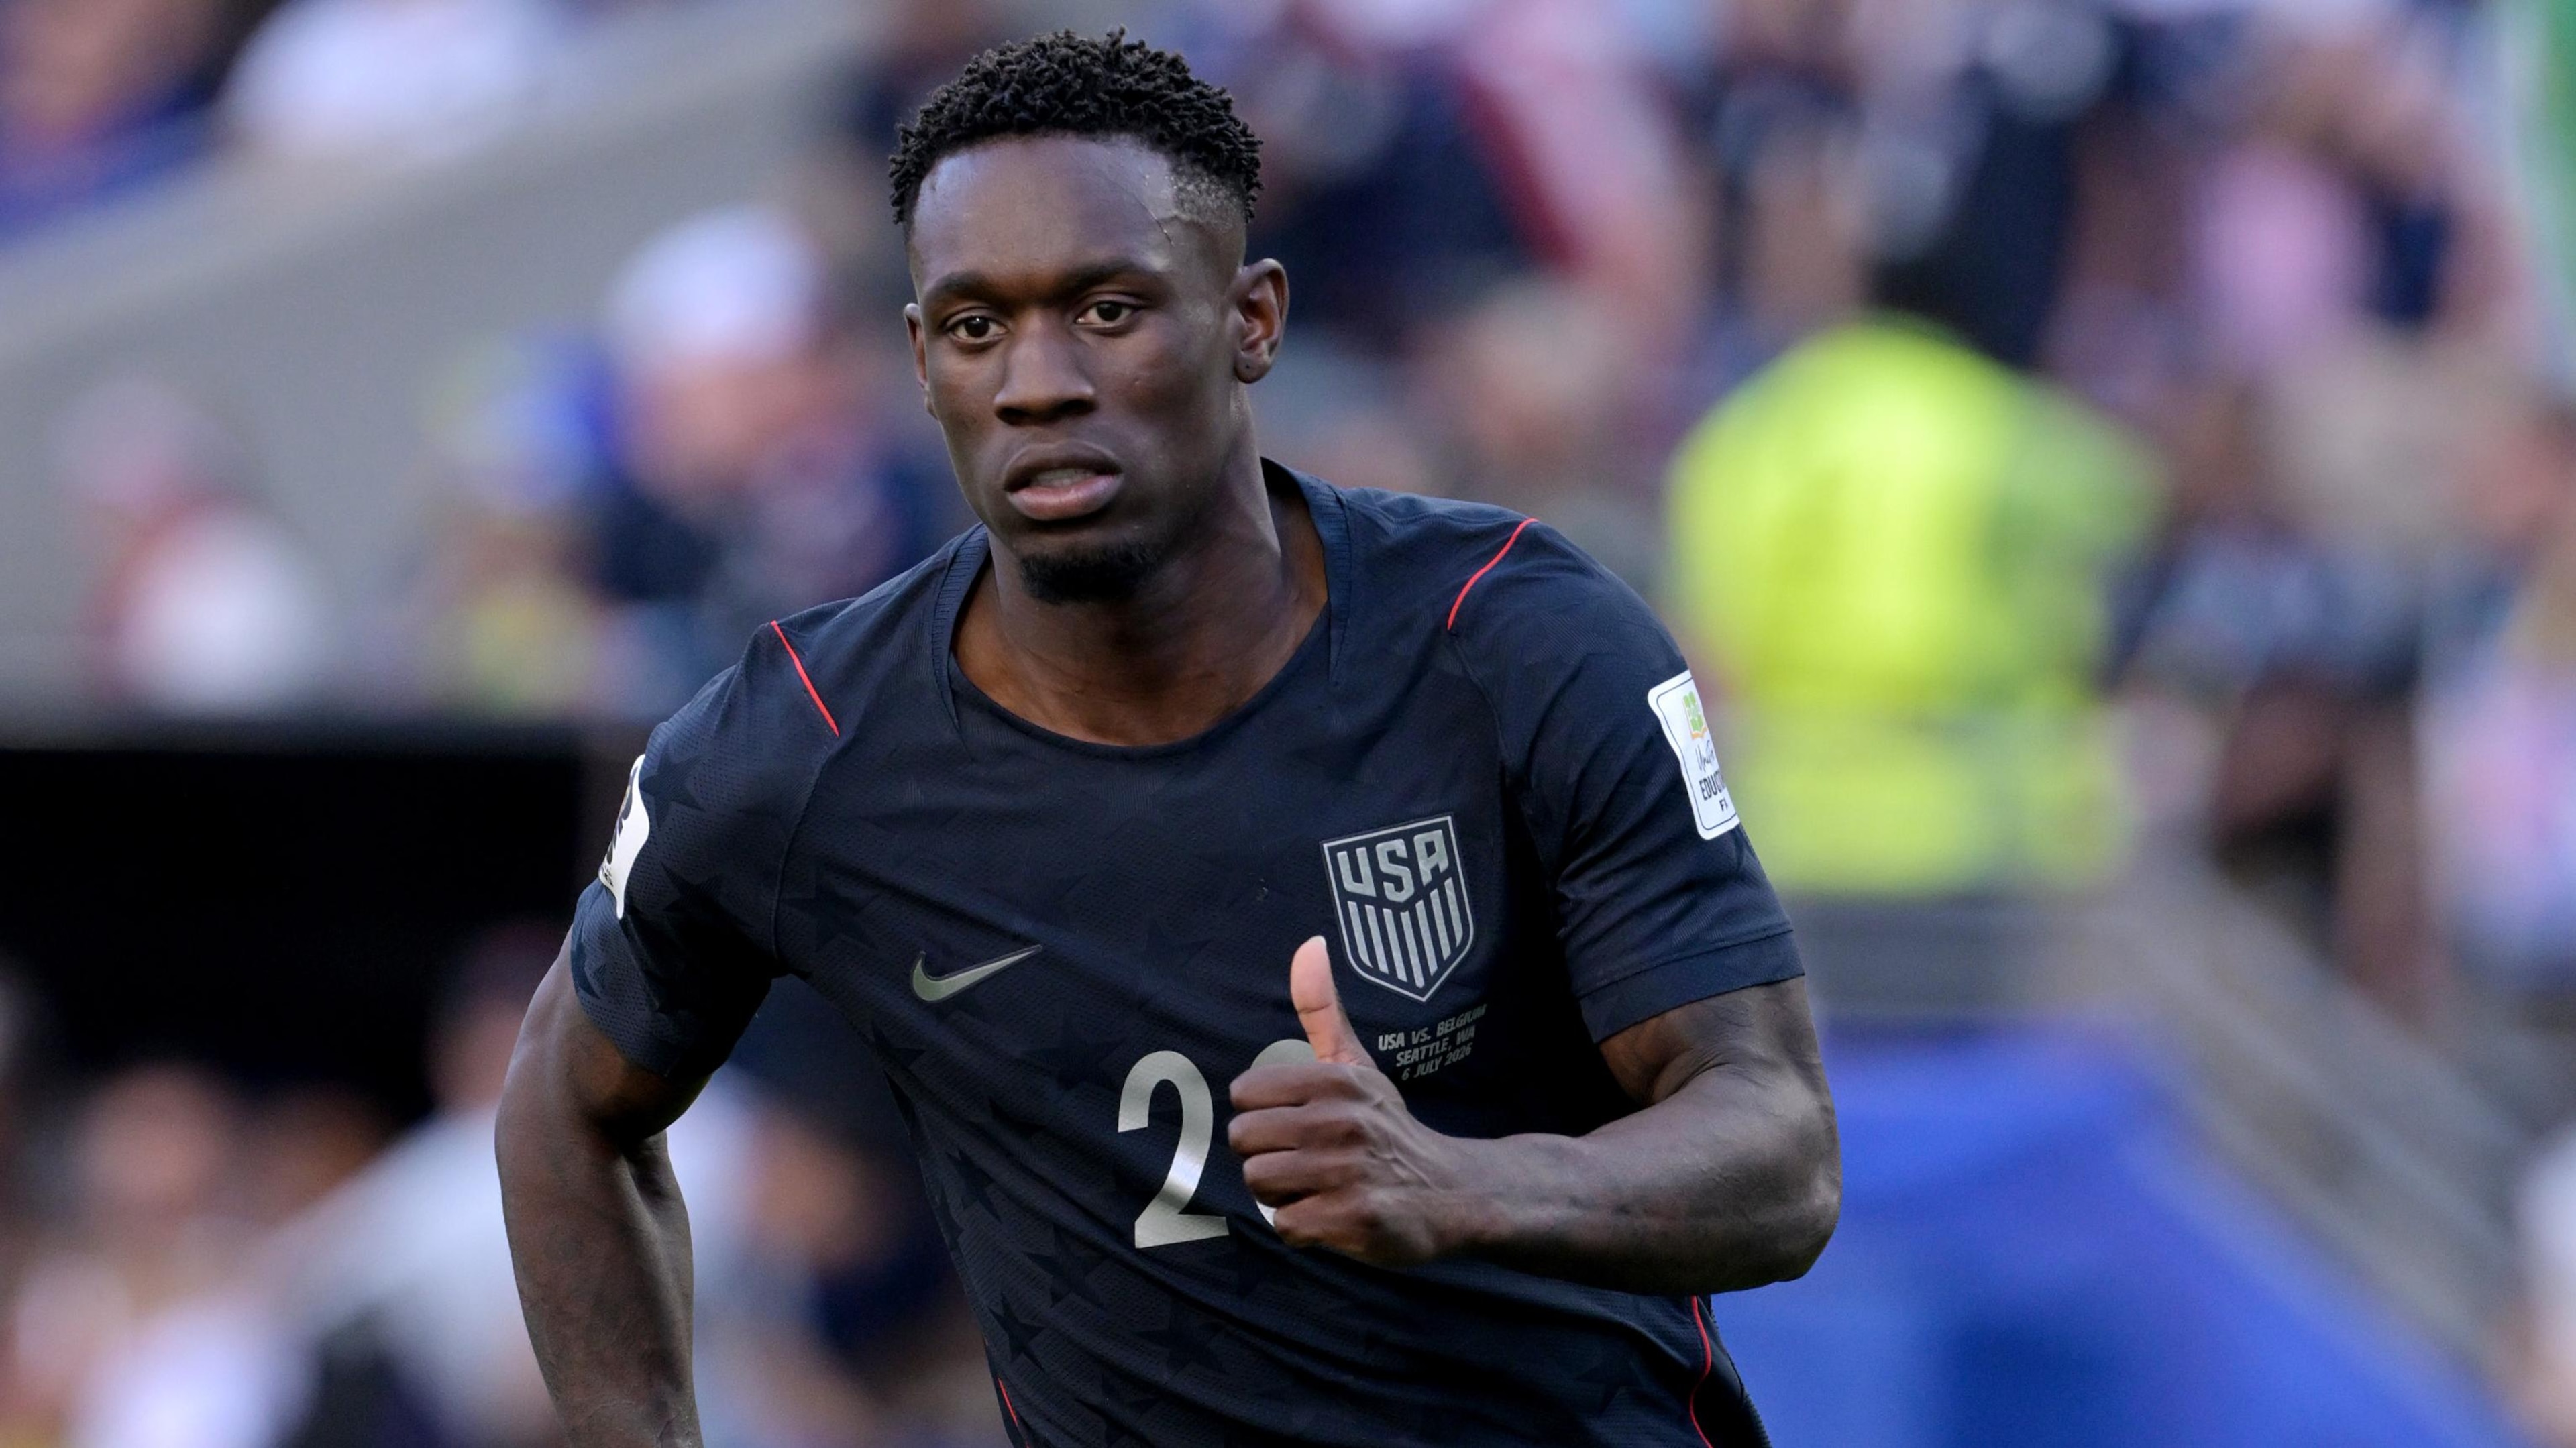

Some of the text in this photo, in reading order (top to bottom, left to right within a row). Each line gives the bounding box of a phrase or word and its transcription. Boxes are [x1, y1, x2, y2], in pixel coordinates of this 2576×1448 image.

[1337, 829, 1449, 903] USA
[1379, 1003, 1487, 1051] USA VS. BELGIUM
[1396, 1025, 1476, 1067] SEATTLE, WA
[1401, 1042, 1473, 1080] 6 JULY 2026
